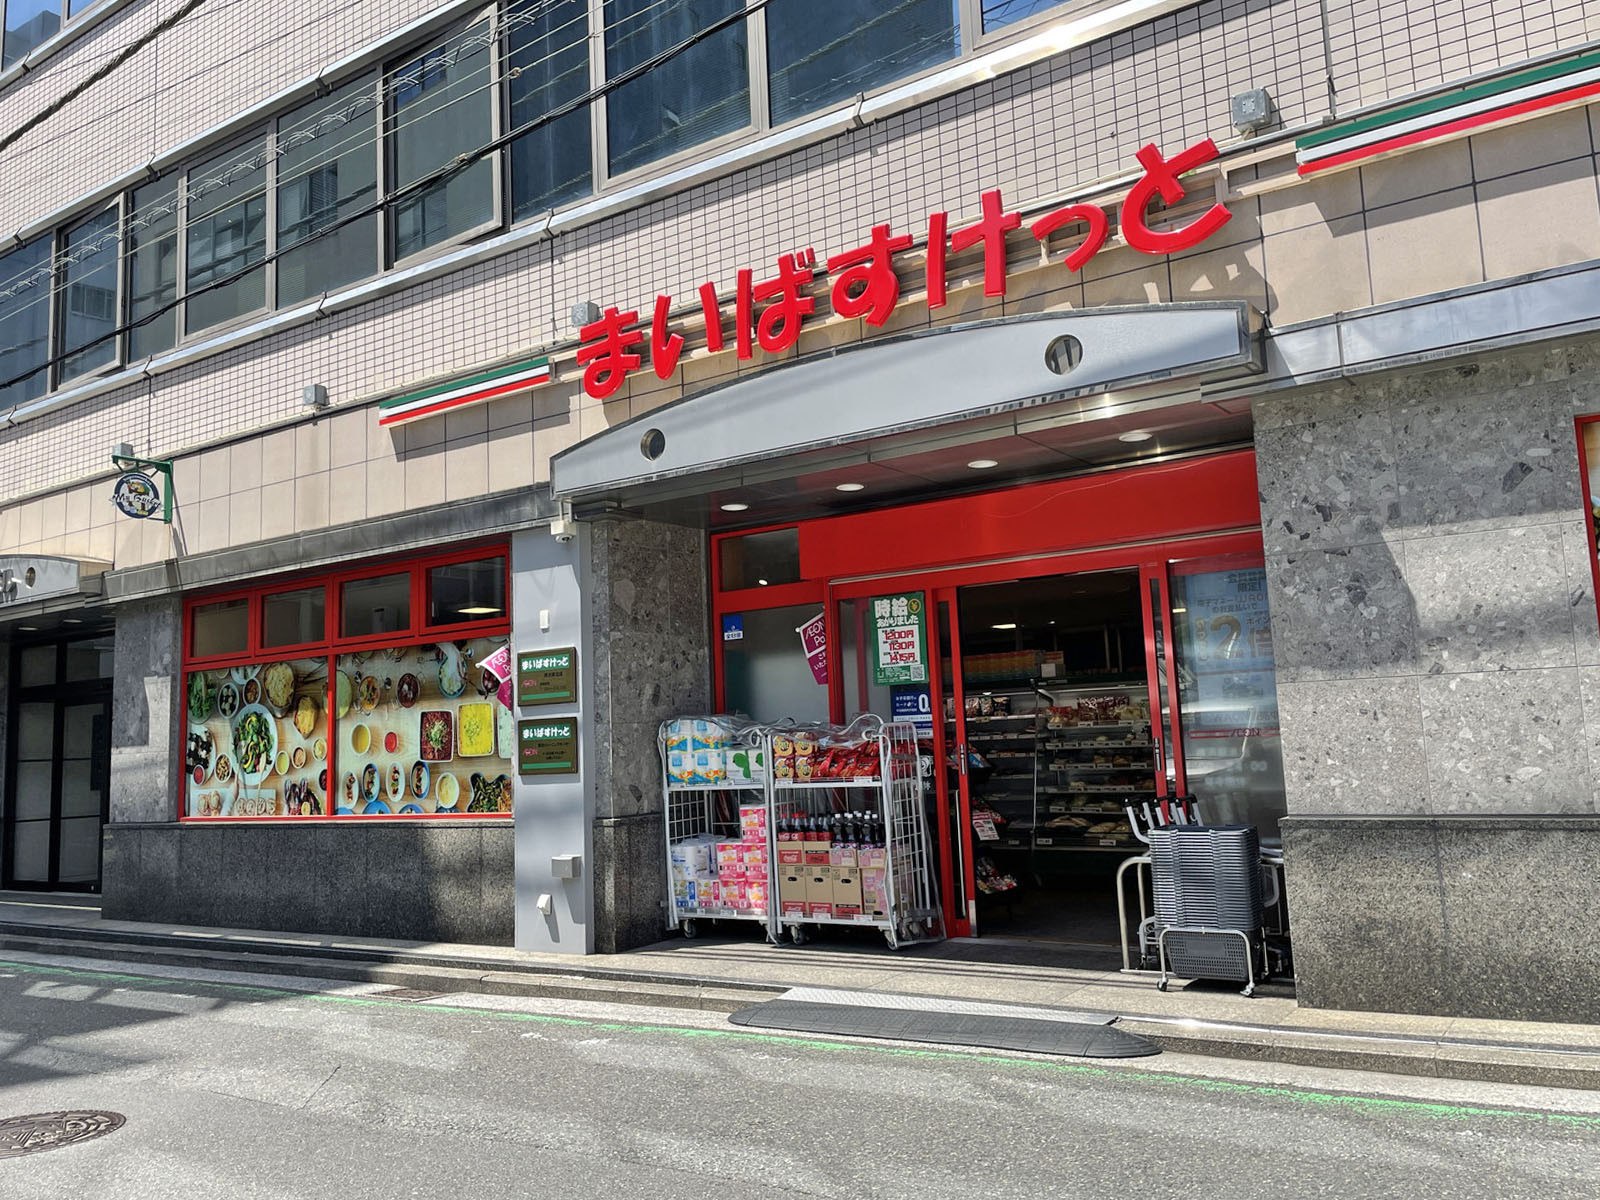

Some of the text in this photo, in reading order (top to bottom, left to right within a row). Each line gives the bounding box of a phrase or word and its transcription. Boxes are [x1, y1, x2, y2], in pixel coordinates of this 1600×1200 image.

[576, 138, 1232, 399] まいばすけっと
[875, 598, 908, 618] 時給
[877, 616, 919, 628] あがりました
[885, 630, 914, 640] 1200円
[889, 641, 915, 651] 1130円
[522, 657, 569, 671] まいばすけっと
[890, 653, 916, 663] 1415円
[523, 727, 570, 739] まいばすけっと
